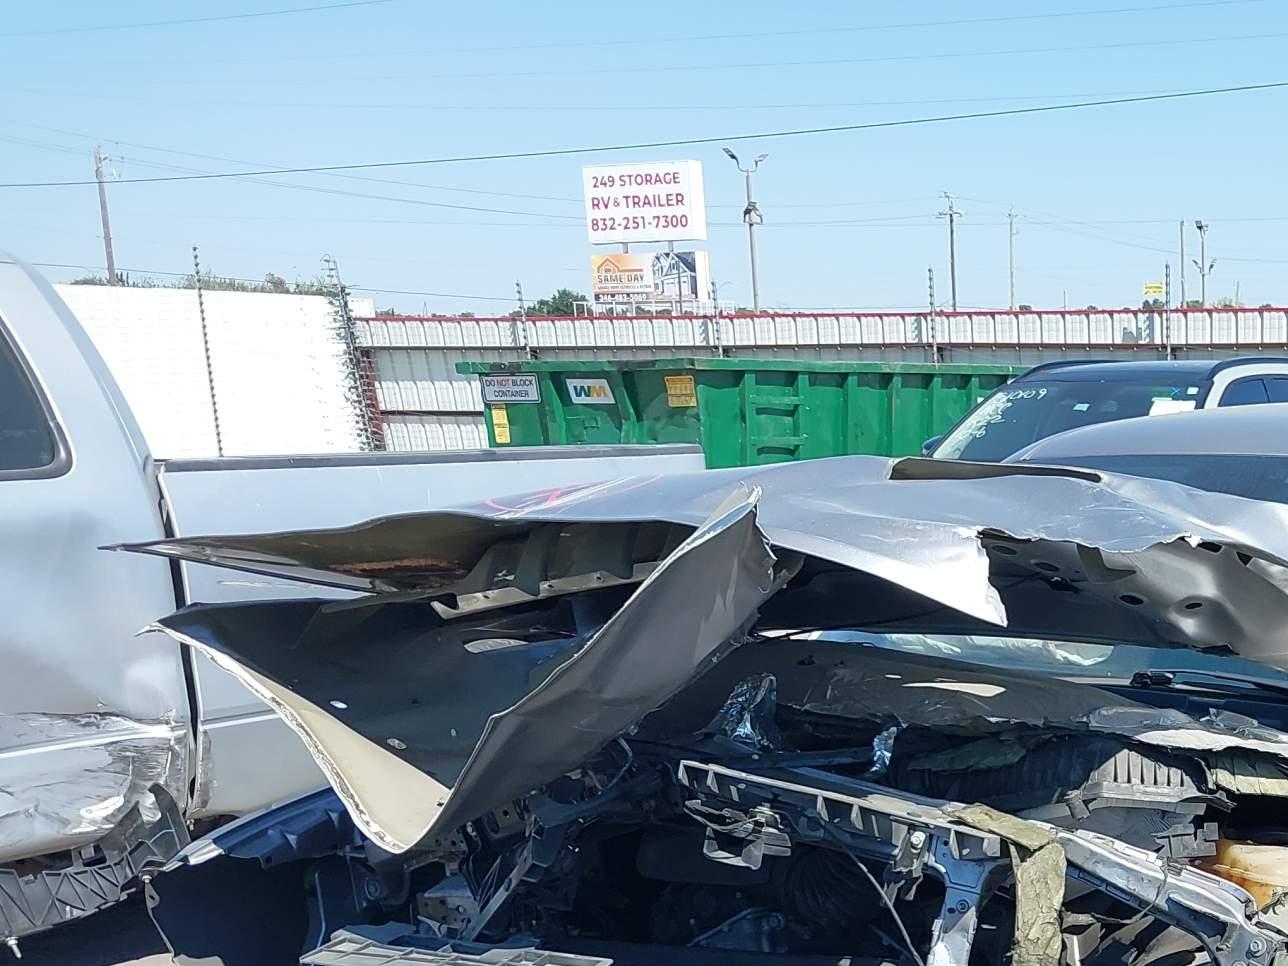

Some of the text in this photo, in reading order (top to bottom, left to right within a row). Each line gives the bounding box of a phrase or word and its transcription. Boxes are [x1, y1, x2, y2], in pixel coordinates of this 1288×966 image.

[592, 172, 681, 189] 249 STORAGE
[591, 193, 685, 210] RV & TRAILER
[591, 214, 688, 231] 832-251-7300
[597, 273, 644, 283] SAME DAY
[485, 378, 534, 387] DO NOT BLOCK
[493, 390, 530, 398] CONTAINER
[572, 385, 609, 397] WM
